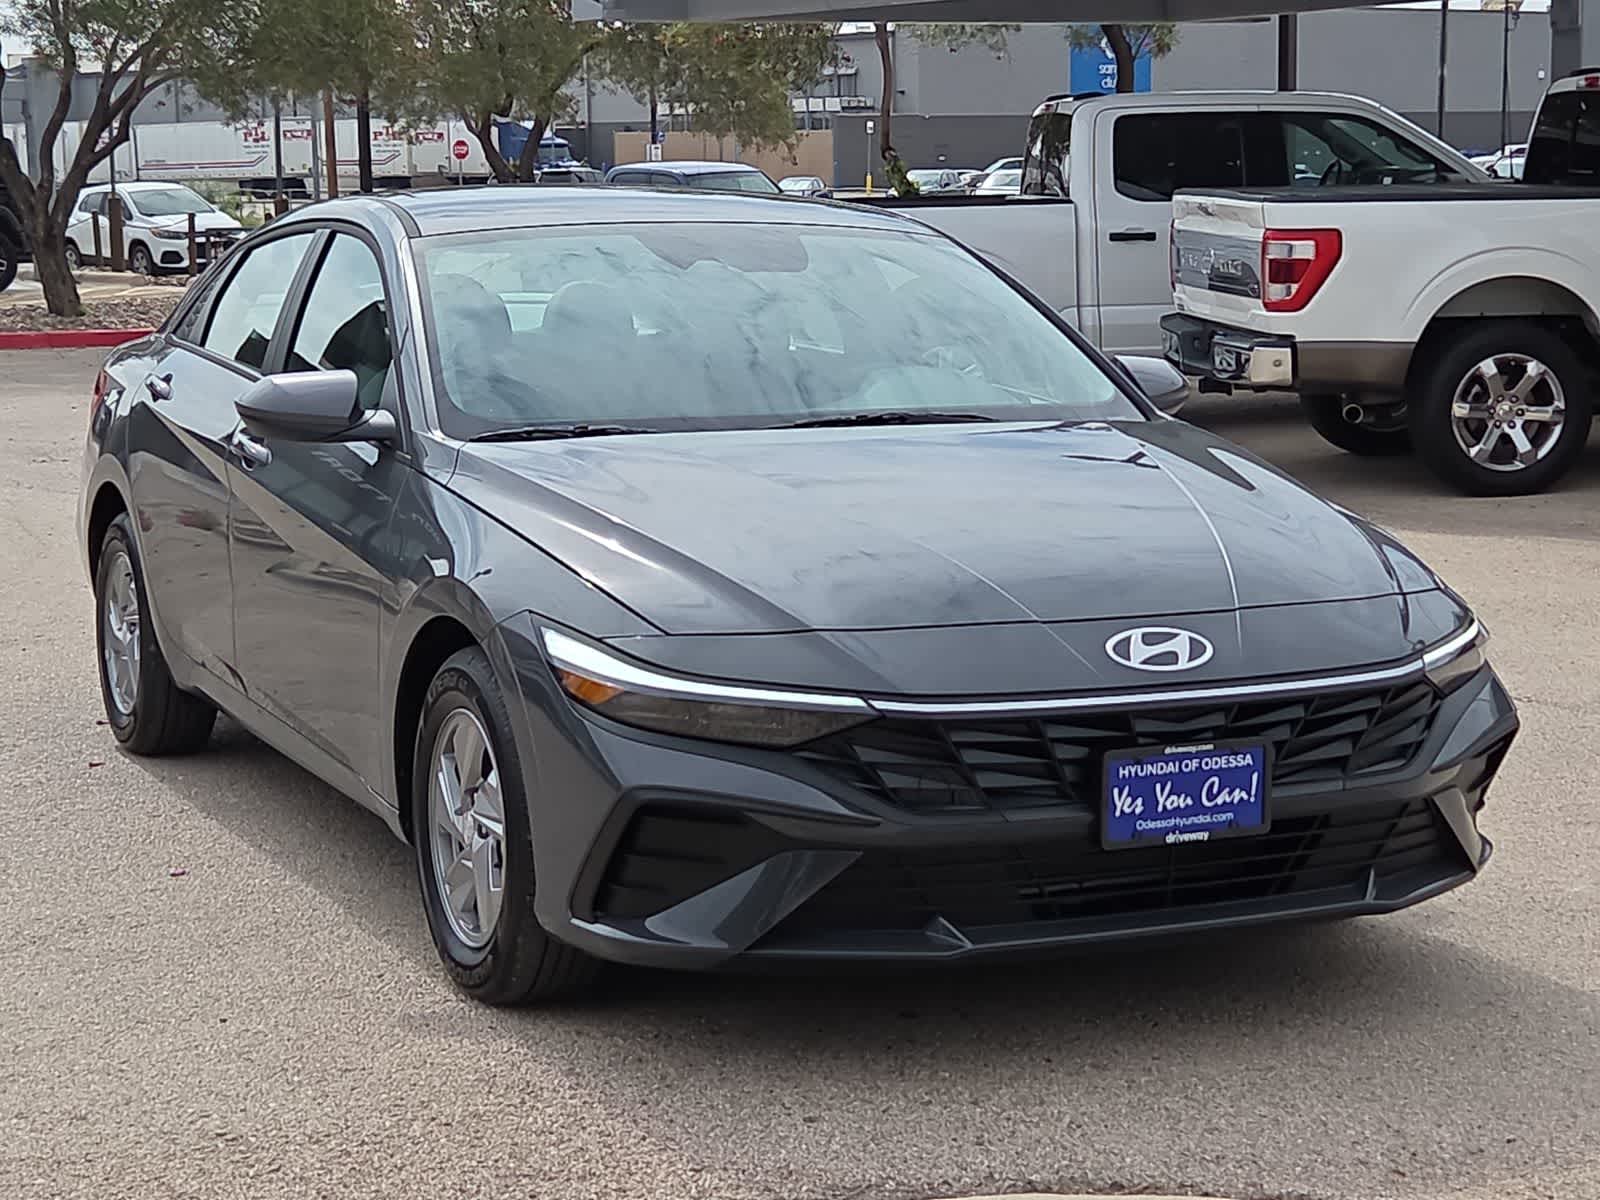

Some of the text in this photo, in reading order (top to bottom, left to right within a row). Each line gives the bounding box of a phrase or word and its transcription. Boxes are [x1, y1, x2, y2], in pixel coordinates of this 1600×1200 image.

[1101, 76, 1117, 88] clu
[1119, 753, 1253, 779] HYUNDAI OF ODESSA
[1112, 772, 1258, 817] Yes You Can!
[1136, 812, 1234, 831] OdessaHyundai.com
[1165, 830, 1209, 844] driveway
